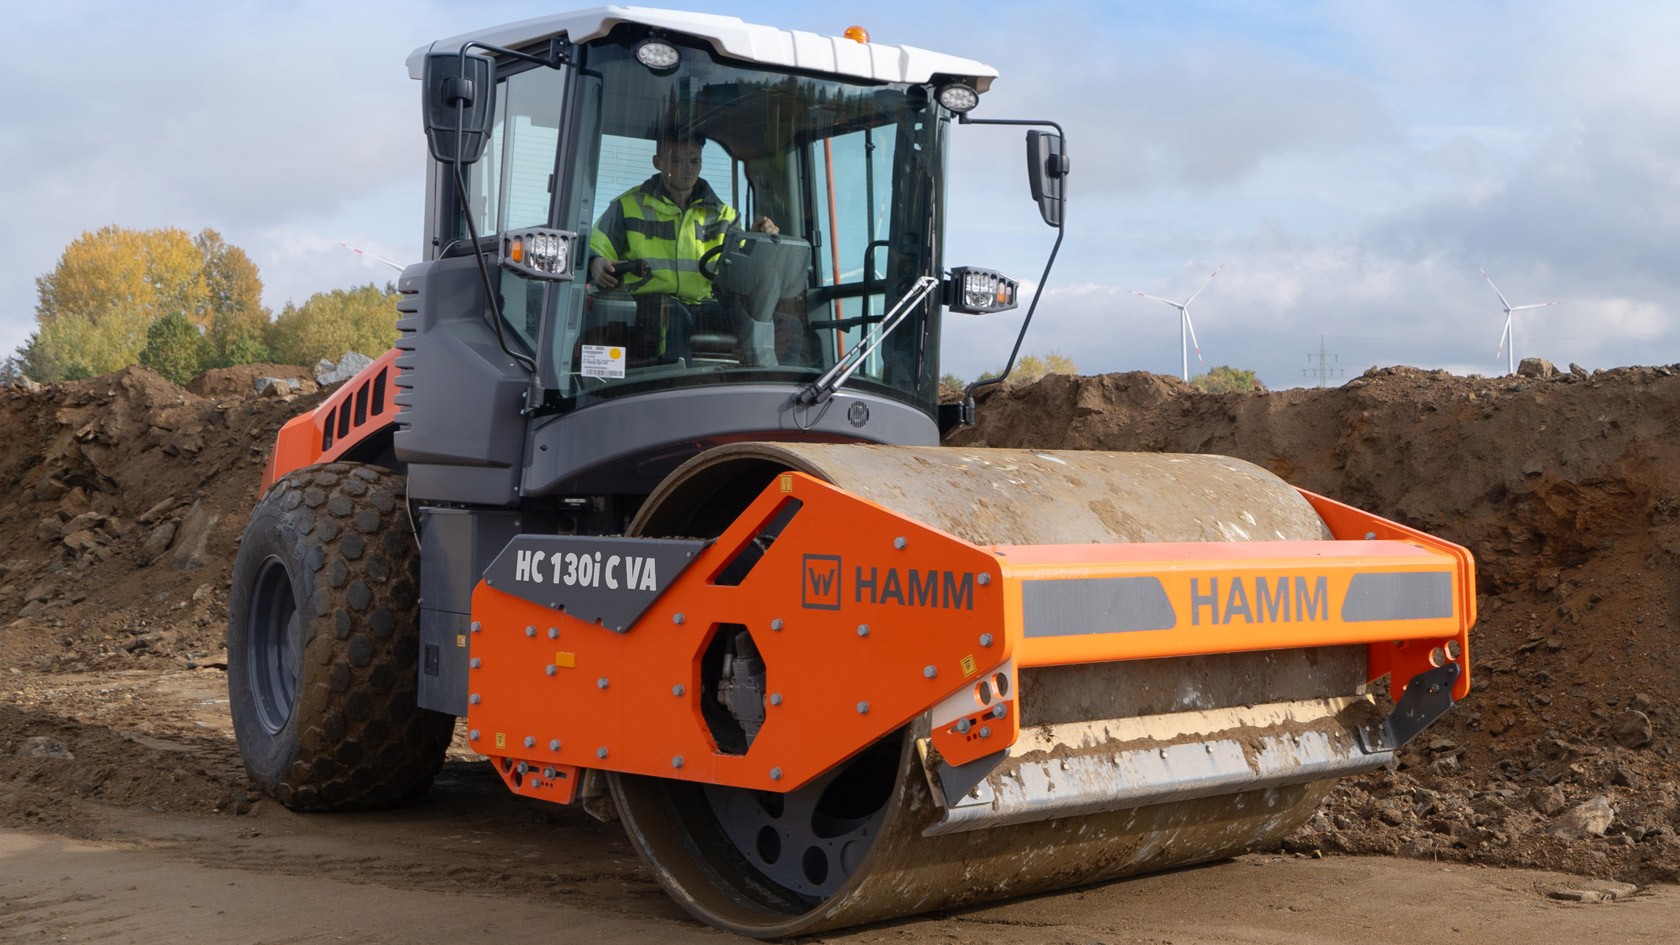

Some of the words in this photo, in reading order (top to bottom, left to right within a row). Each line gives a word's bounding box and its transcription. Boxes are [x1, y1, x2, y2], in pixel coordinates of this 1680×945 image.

[515, 549, 546, 583] HC
[550, 551, 601, 588] 130i
[605, 555, 621, 590] C
[625, 556, 657, 591] VA
[855, 566, 974, 611] HAMM
[1190, 575, 1329, 626] HAMM
